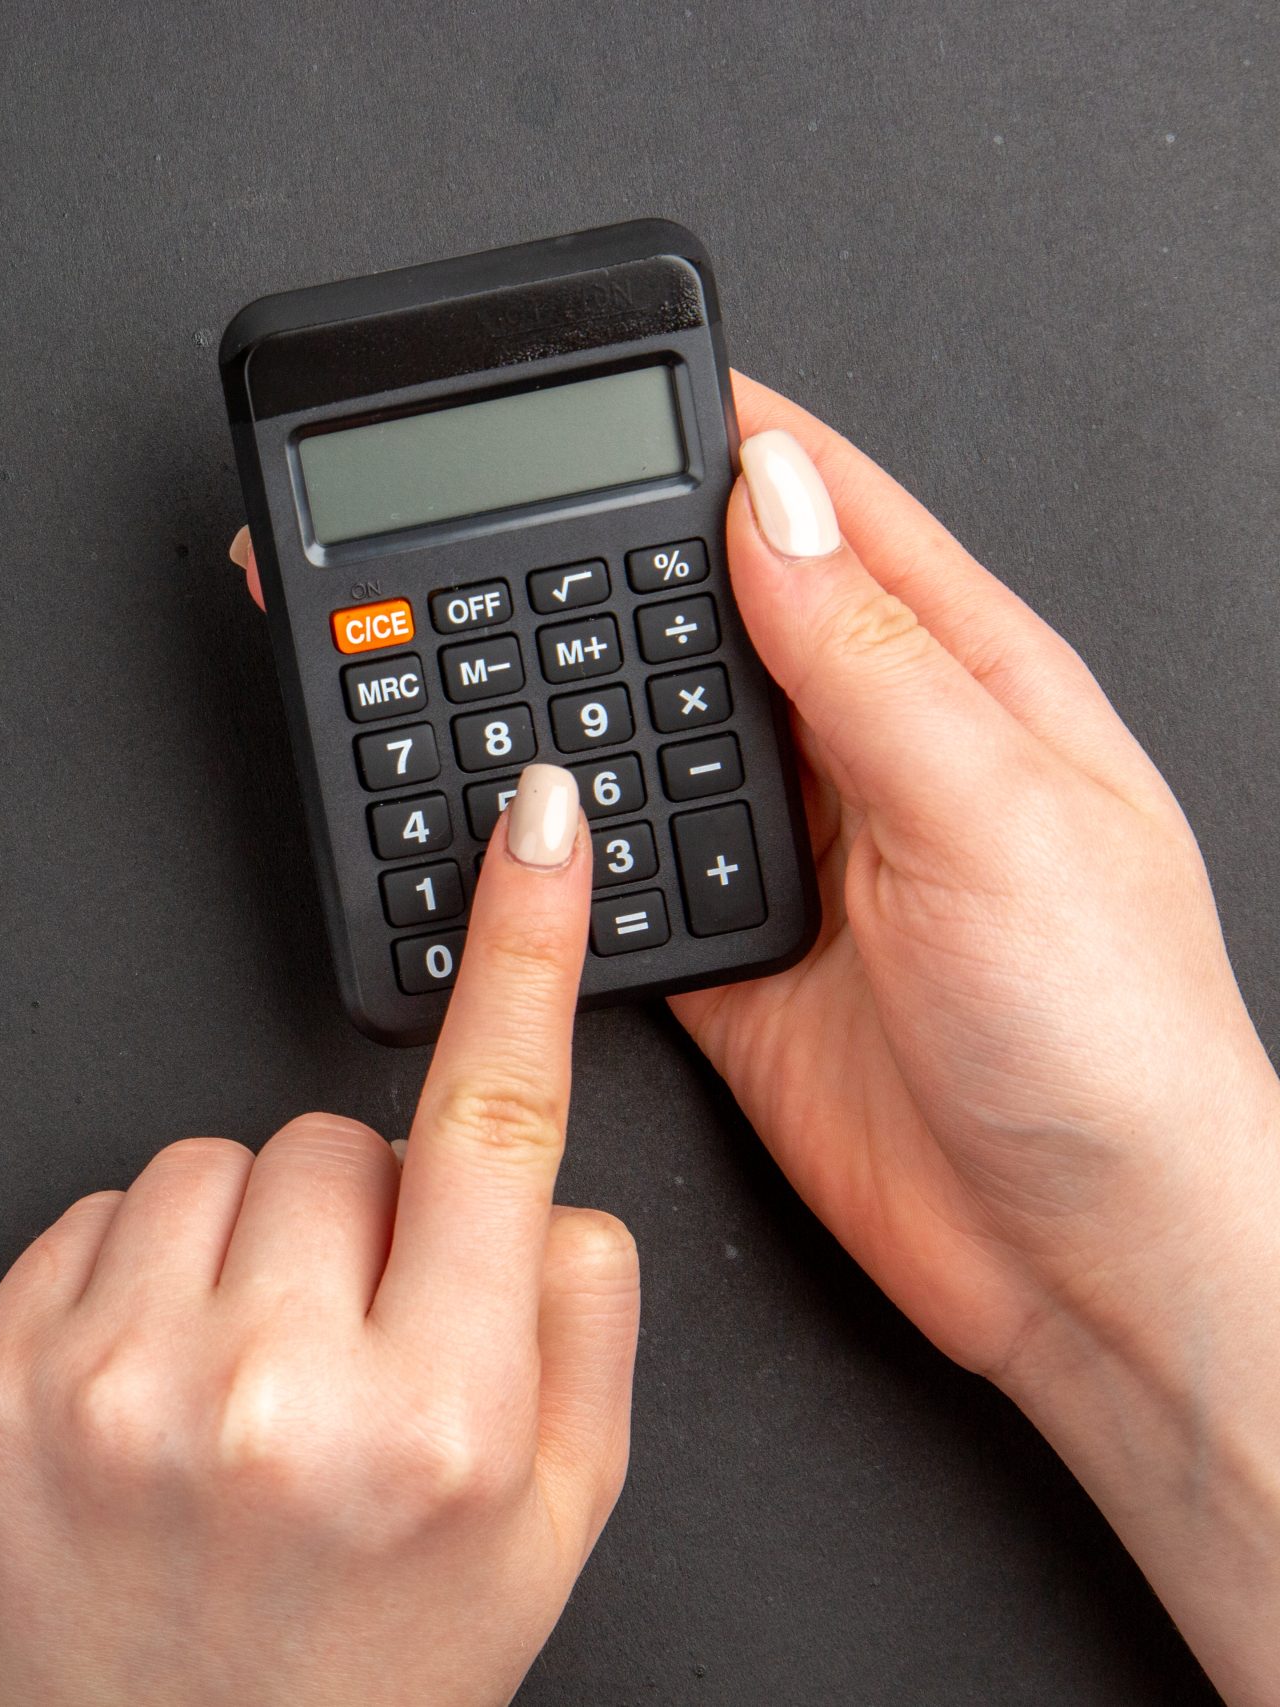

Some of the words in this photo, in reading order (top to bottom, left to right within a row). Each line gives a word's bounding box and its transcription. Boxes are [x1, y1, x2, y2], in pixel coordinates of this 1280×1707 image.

[654, 550, 690, 580] %
[351, 579, 382, 599] ON
[447, 591, 501, 624] OFF
[345, 610, 410, 645] C/CE
[665, 615, 698, 644] ÷
[556, 636, 608, 667] M+
[357, 672, 420, 707] MRC
[580, 702, 609, 738] 9
[484, 721, 512, 756] 8
[386, 738, 413, 775] 7
[593, 771, 621, 806] 6
[402, 810, 430, 844] 4
[606, 838, 634, 874] 3
[706, 855, 739, 886] +
[415, 877, 437, 911] 1
[615, 911, 649, 935] =
[426, 944, 453, 979] 0
